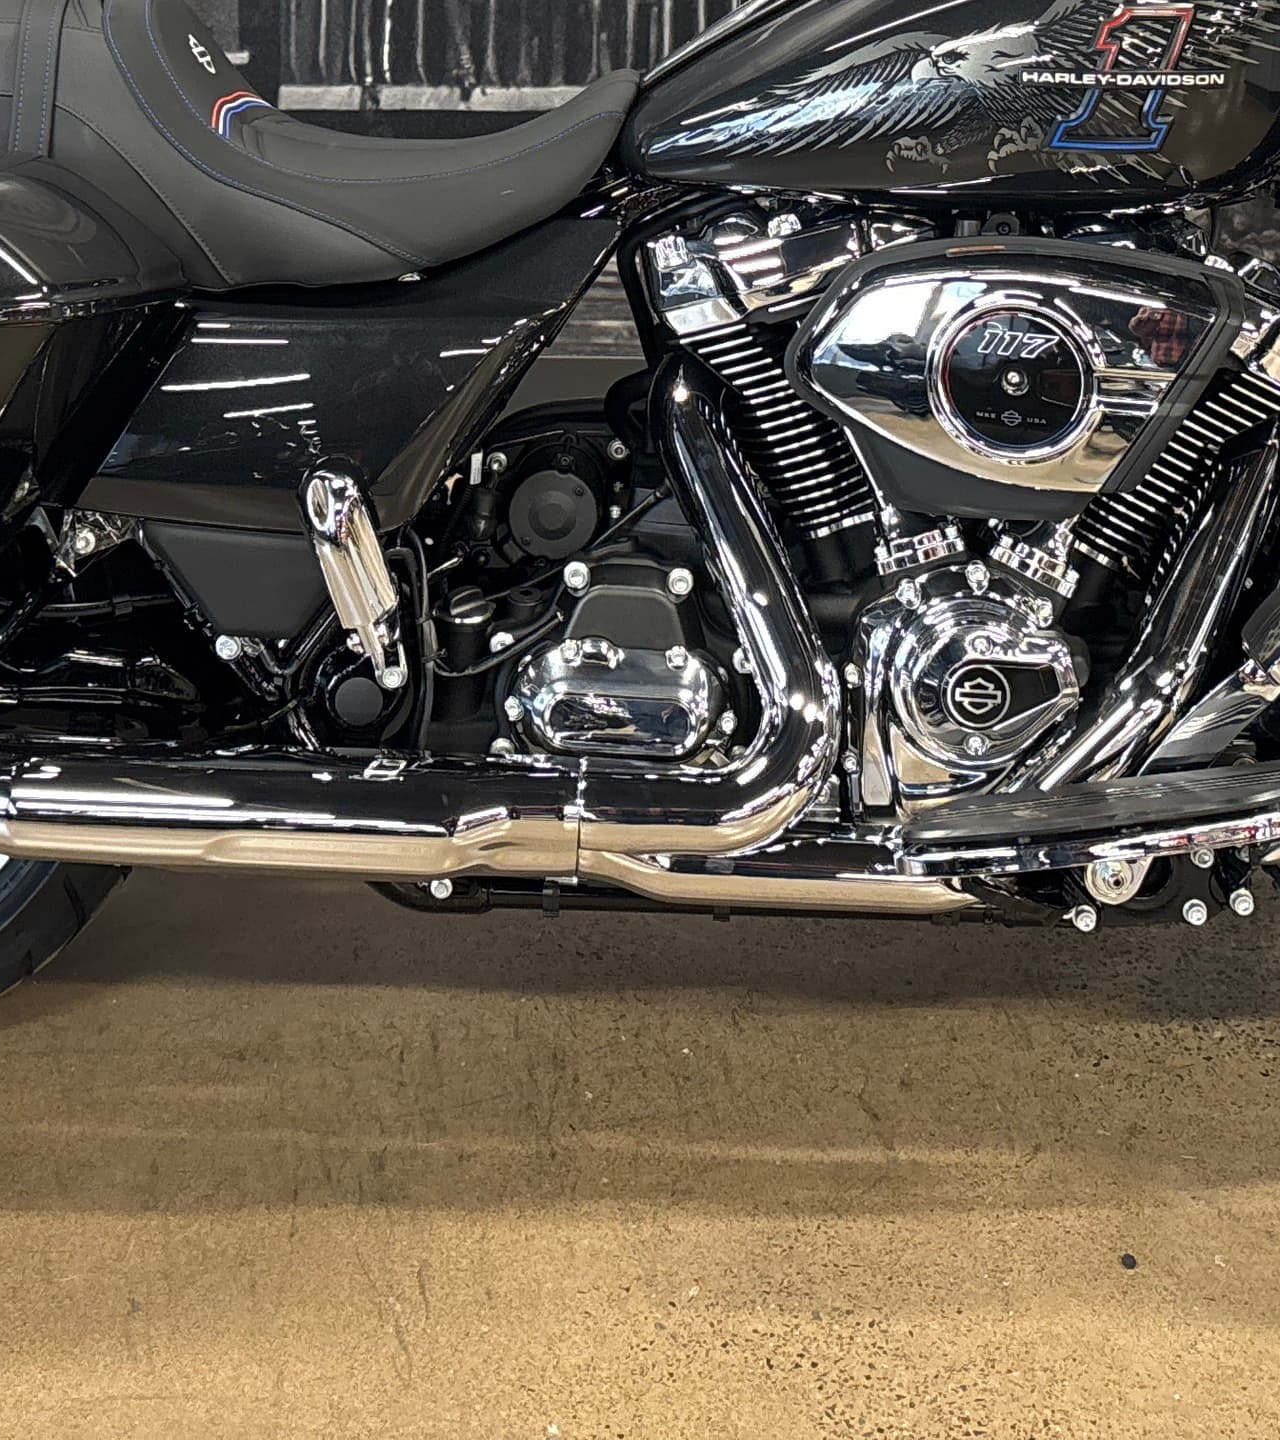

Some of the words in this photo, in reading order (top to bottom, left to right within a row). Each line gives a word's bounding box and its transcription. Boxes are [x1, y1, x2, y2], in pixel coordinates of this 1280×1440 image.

[1022, 71, 1225, 86] HARLEY-DAVIDSON
[977, 329, 1059, 358] 117
[1026, 417, 1047, 425] USA
